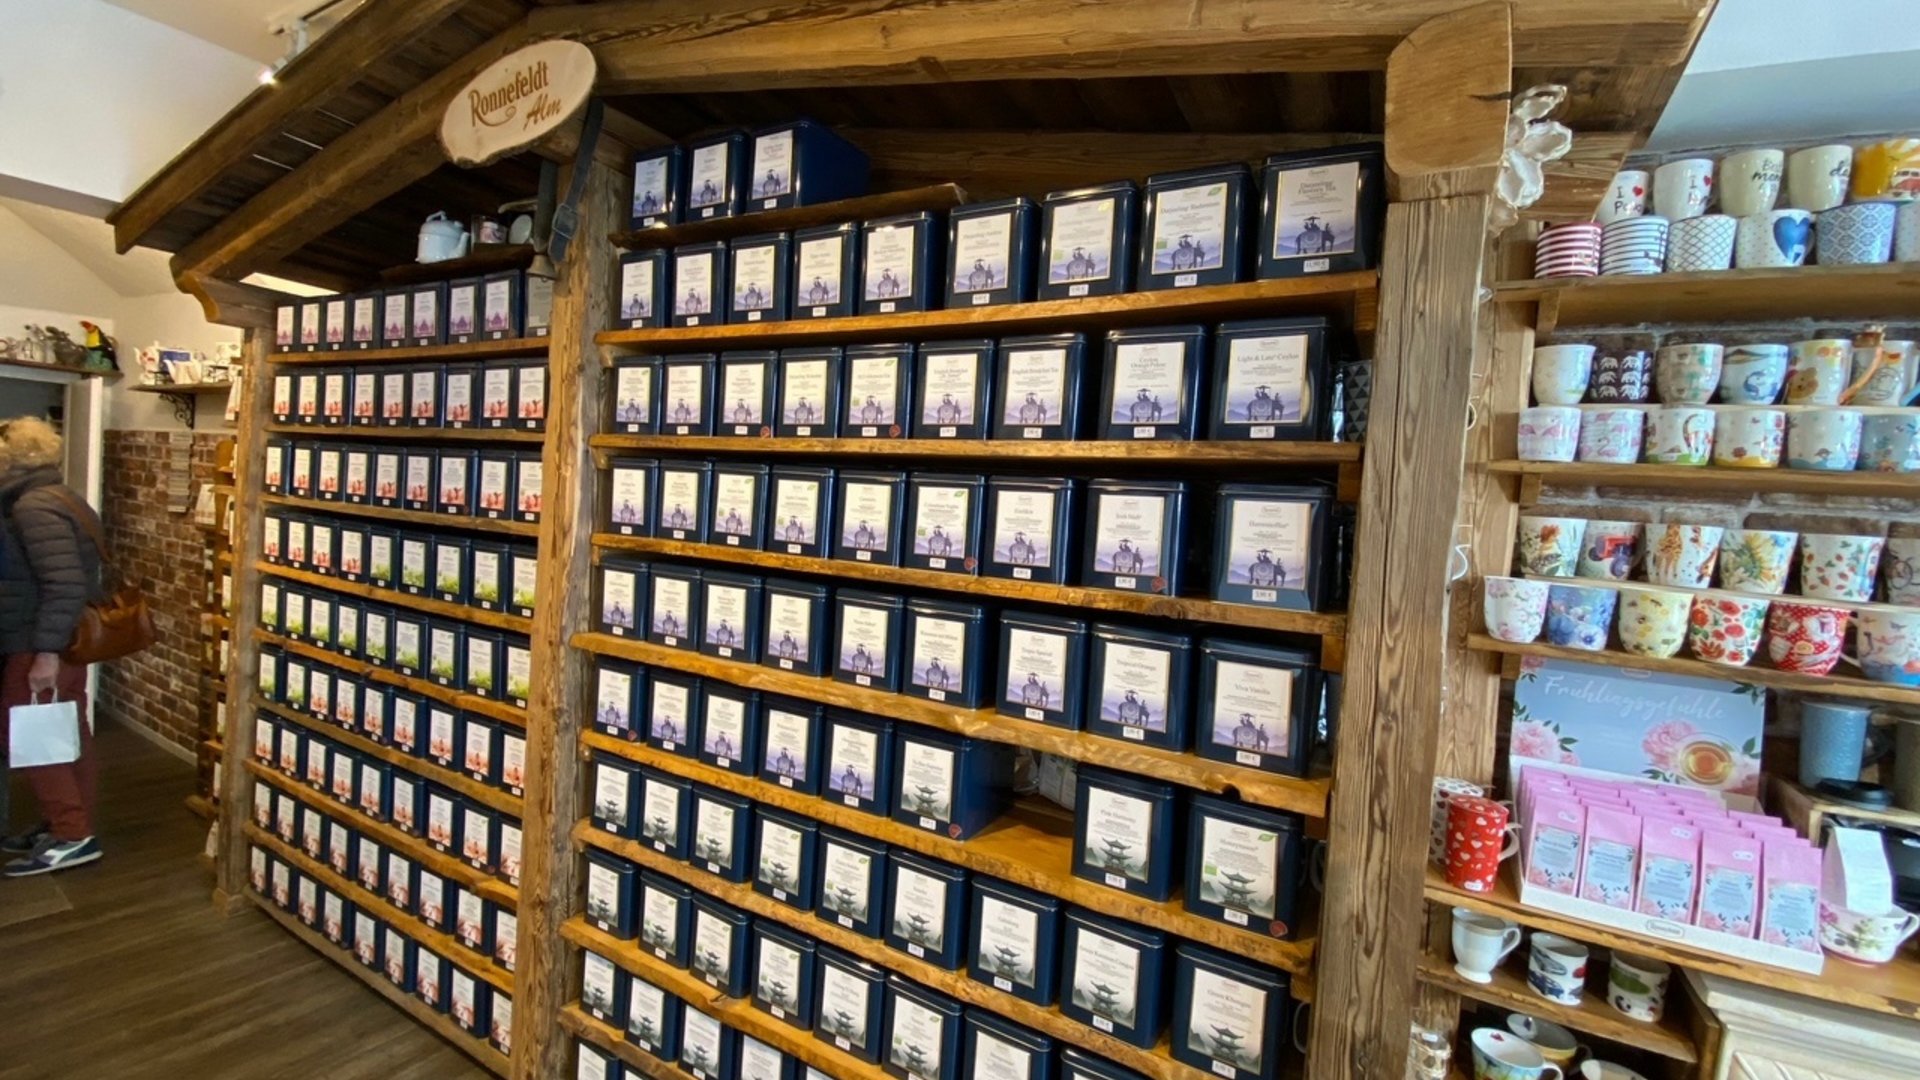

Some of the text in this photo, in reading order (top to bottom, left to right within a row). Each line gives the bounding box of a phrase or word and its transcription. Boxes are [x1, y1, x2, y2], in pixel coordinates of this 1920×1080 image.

[468, 61, 549, 128] Ronnefeldt
[523, 93, 562, 131] Alm
[1616, 186, 1624, 199] I
[1545, 676, 1726, 720] Frühlingsgefühle
